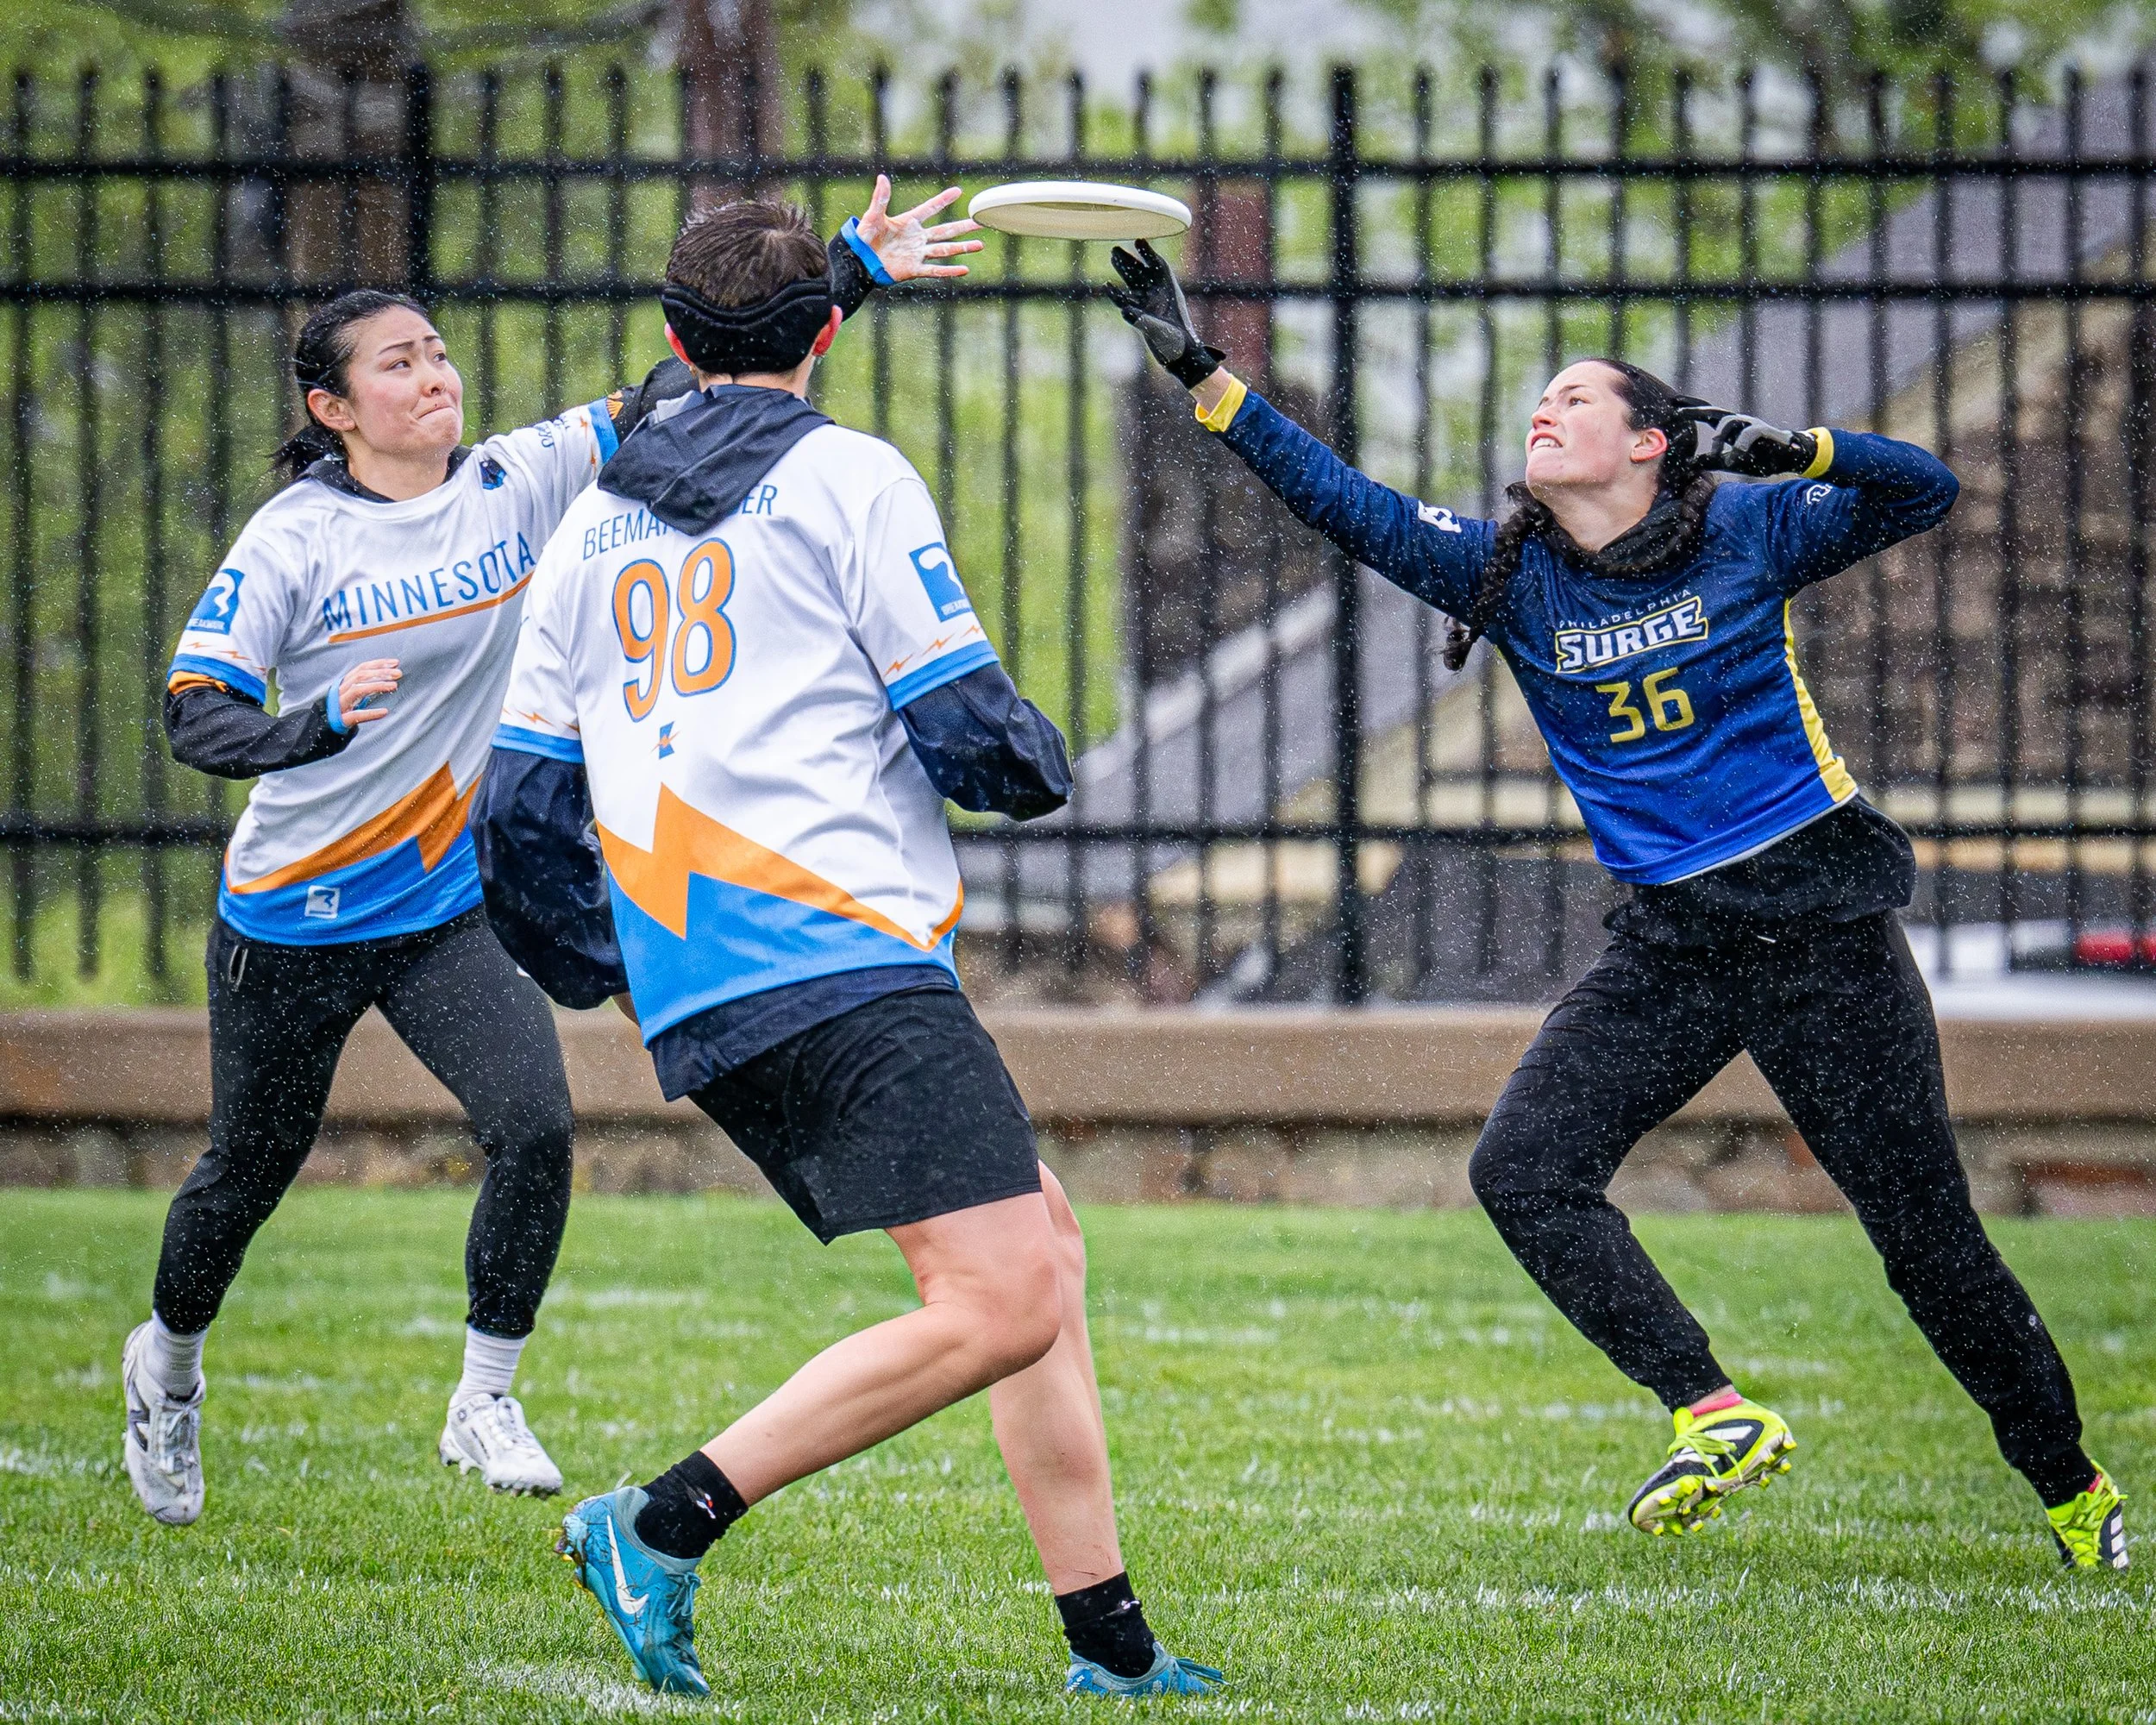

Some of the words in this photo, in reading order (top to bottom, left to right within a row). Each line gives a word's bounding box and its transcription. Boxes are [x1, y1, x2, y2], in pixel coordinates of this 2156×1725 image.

[582, 484, 778, 561] BEEMAER
[322, 530, 536, 631] MINNESOTA
[1558, 588, 1691, 630] PHILADELPHIA
[611, 536, 736, 723] 98
[1558, 602, 1703, 669] SURGE
[1595, 667, 1695, 743] 36
